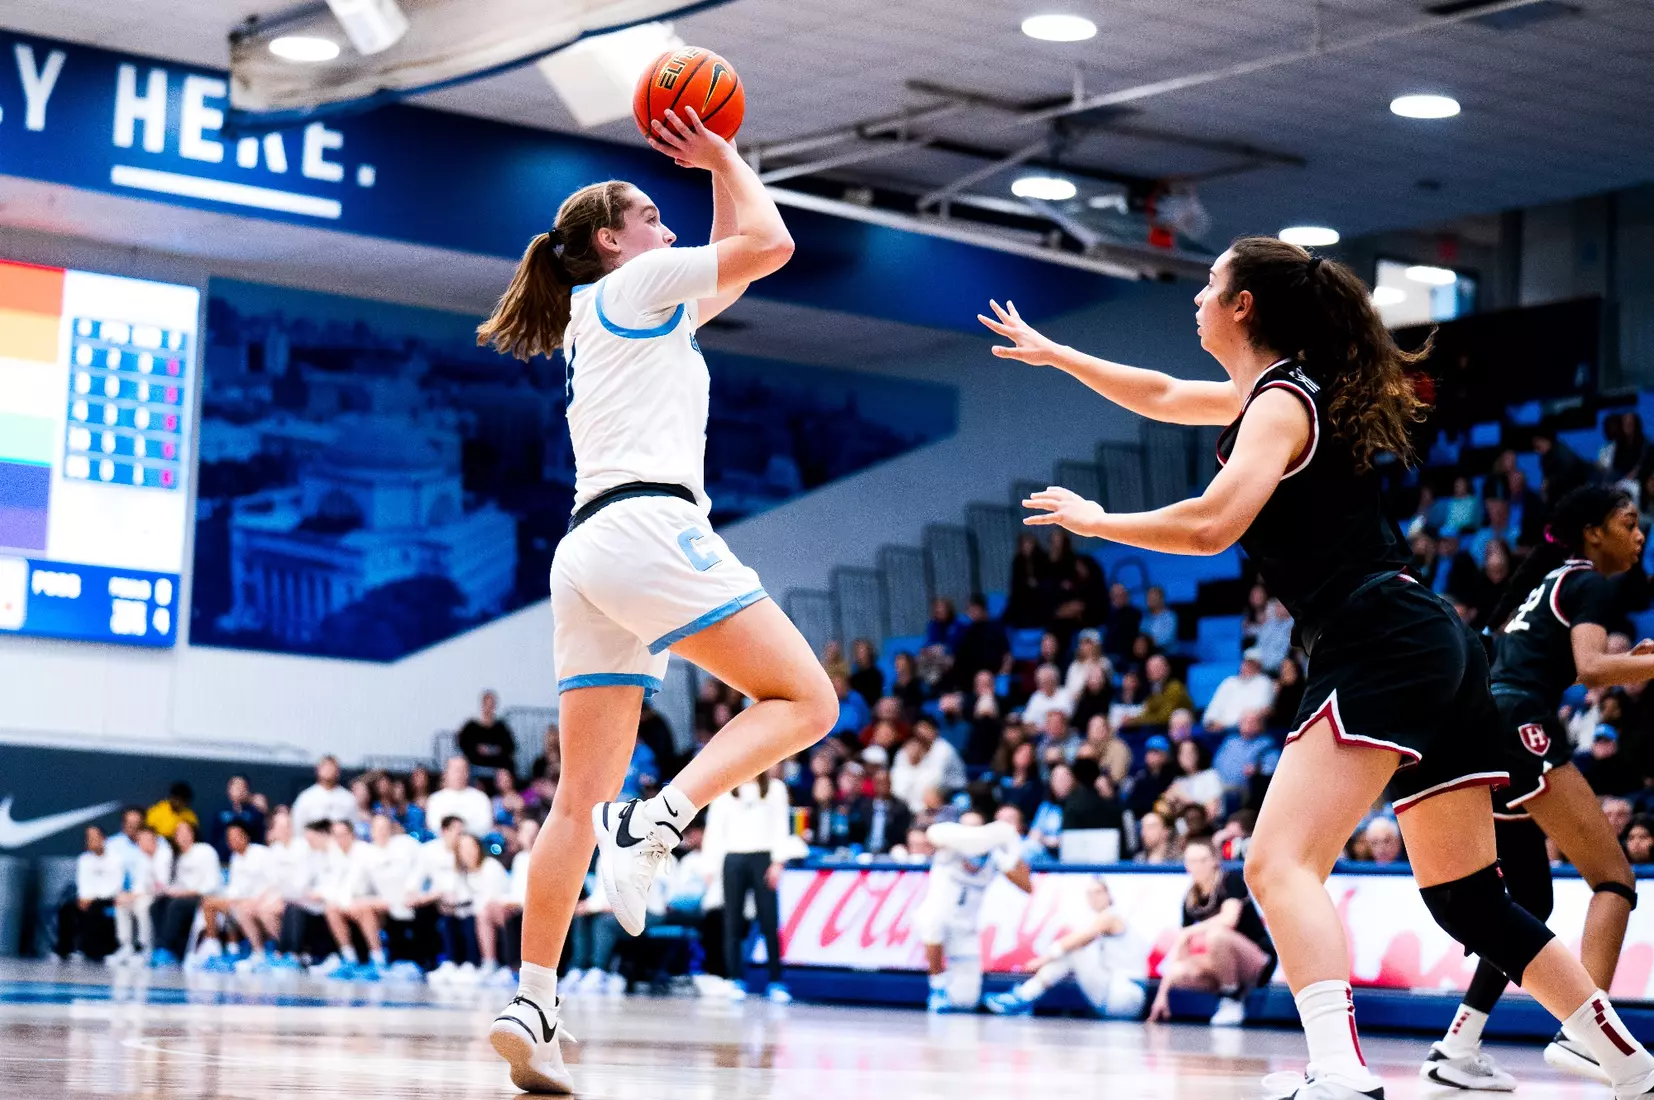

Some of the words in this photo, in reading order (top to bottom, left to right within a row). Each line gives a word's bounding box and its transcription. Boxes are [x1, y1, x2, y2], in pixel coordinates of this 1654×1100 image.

[0, 43, 66, 131] Y
[677, 526, 722, 572] C
[1526, 727, 1546, 747] H
